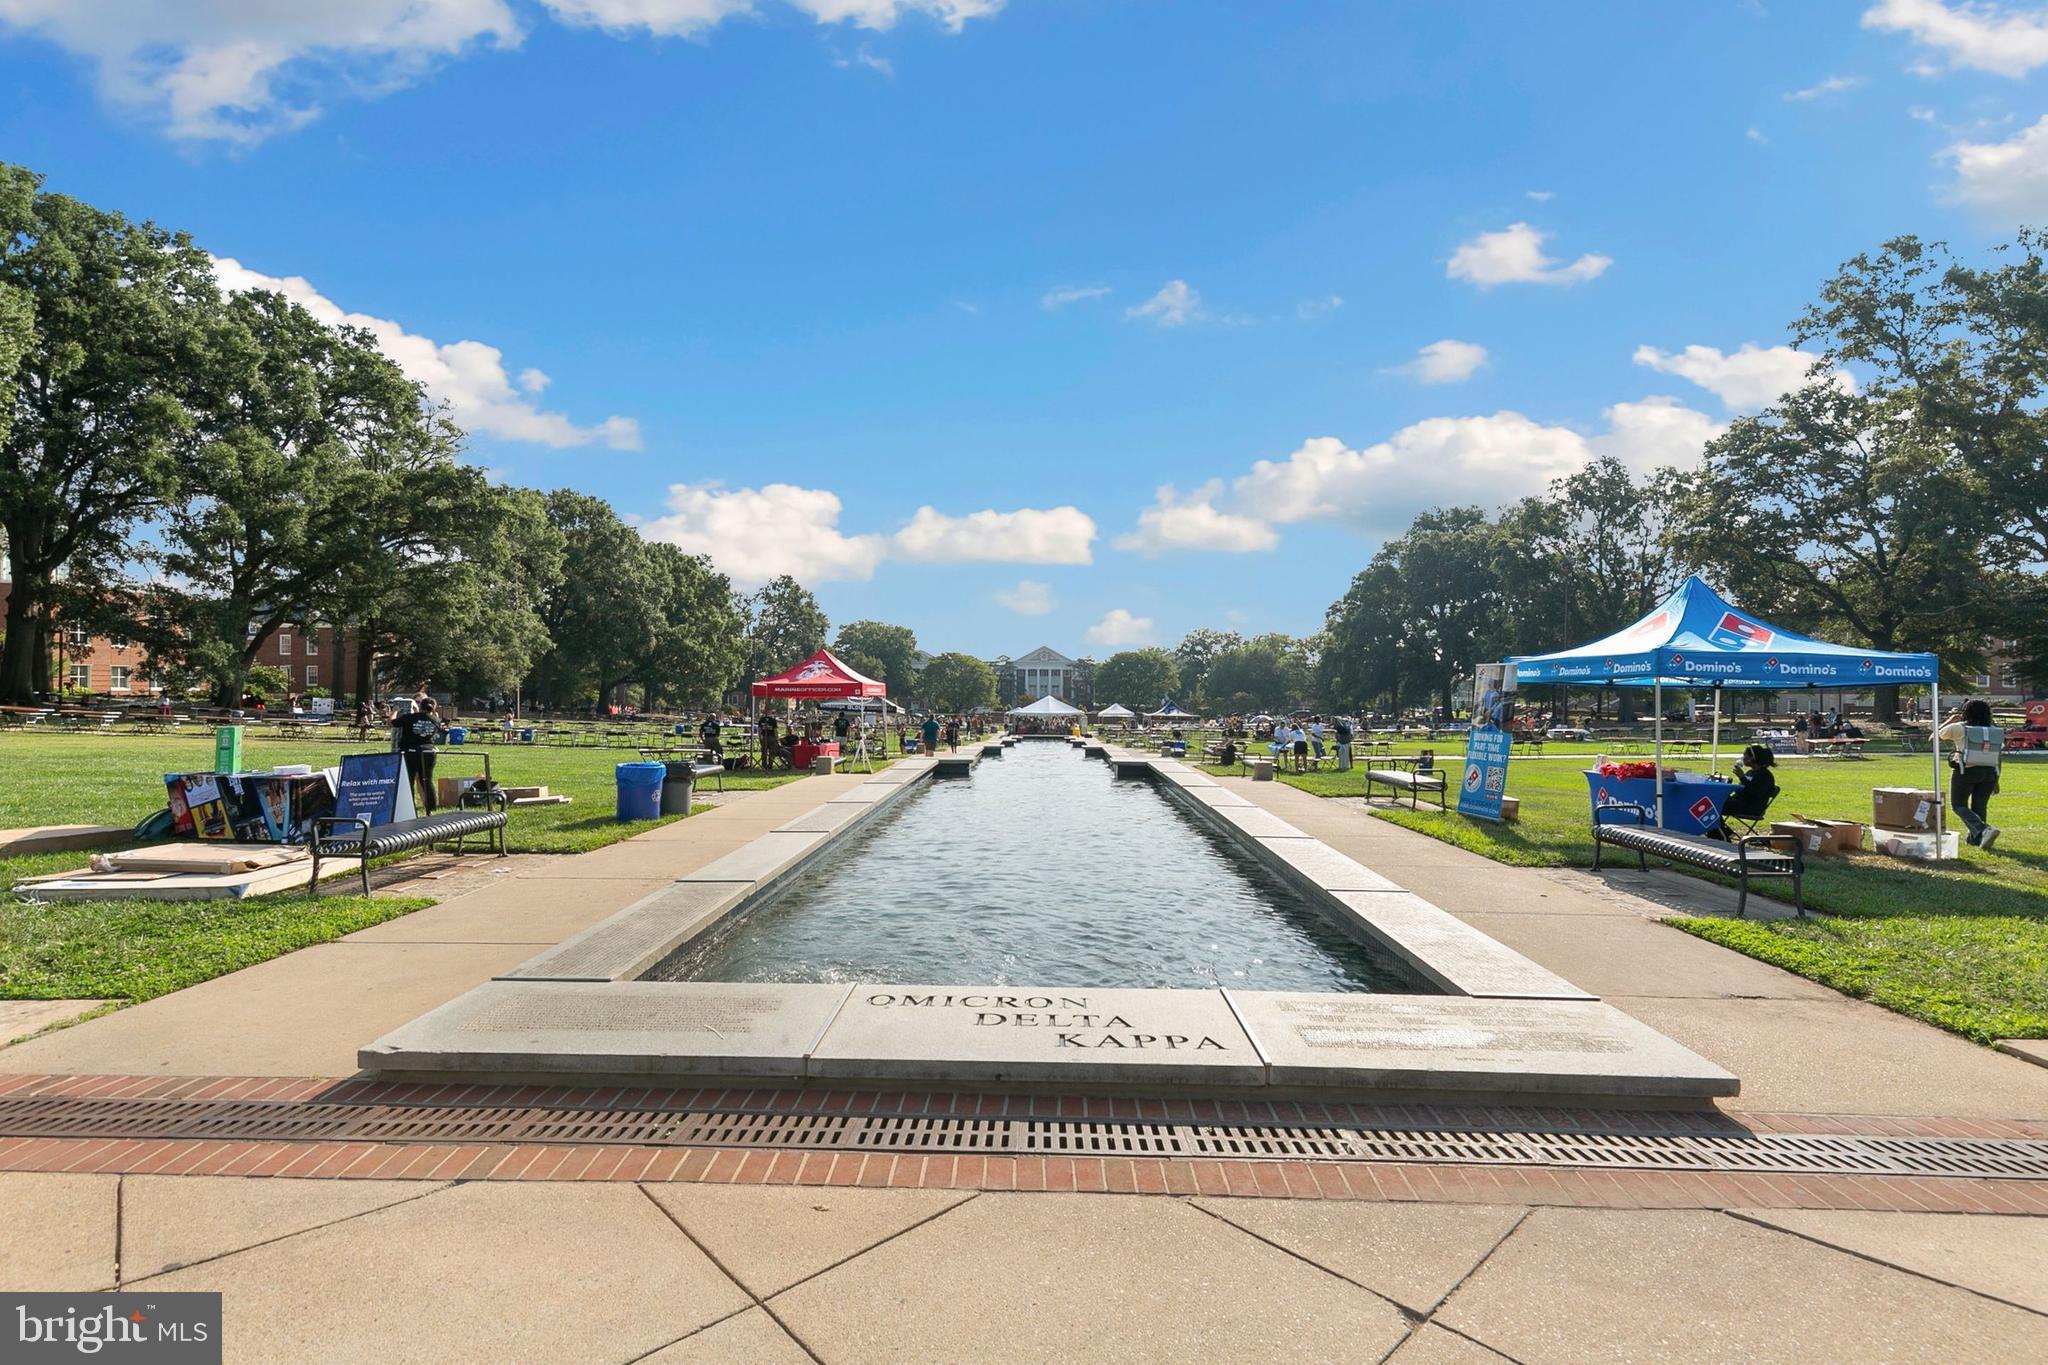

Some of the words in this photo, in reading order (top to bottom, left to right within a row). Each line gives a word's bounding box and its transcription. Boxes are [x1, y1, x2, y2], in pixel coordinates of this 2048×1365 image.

[1558, 665, 1591, 677] Domino's
[1613, 661, 1652, 674] Domino's
[1685, 660, 1742, 673] Domino's
[1780, 663, 1837, 676] Domino's
[1874, 665, 1932, 678] Domino's
[1494, 734, 1504, 743] FOR
[1473, 742, 1500, 753] PART-TIME
[1488, 753, 1507, 763] WORK?
[362, 778, 378, 786] with
[866, 994, 1090, 1010] OMICRON
[973, 1012, 1135, 1028] DELTA
[1055, 1032, 1231, 1050] KAPPA
